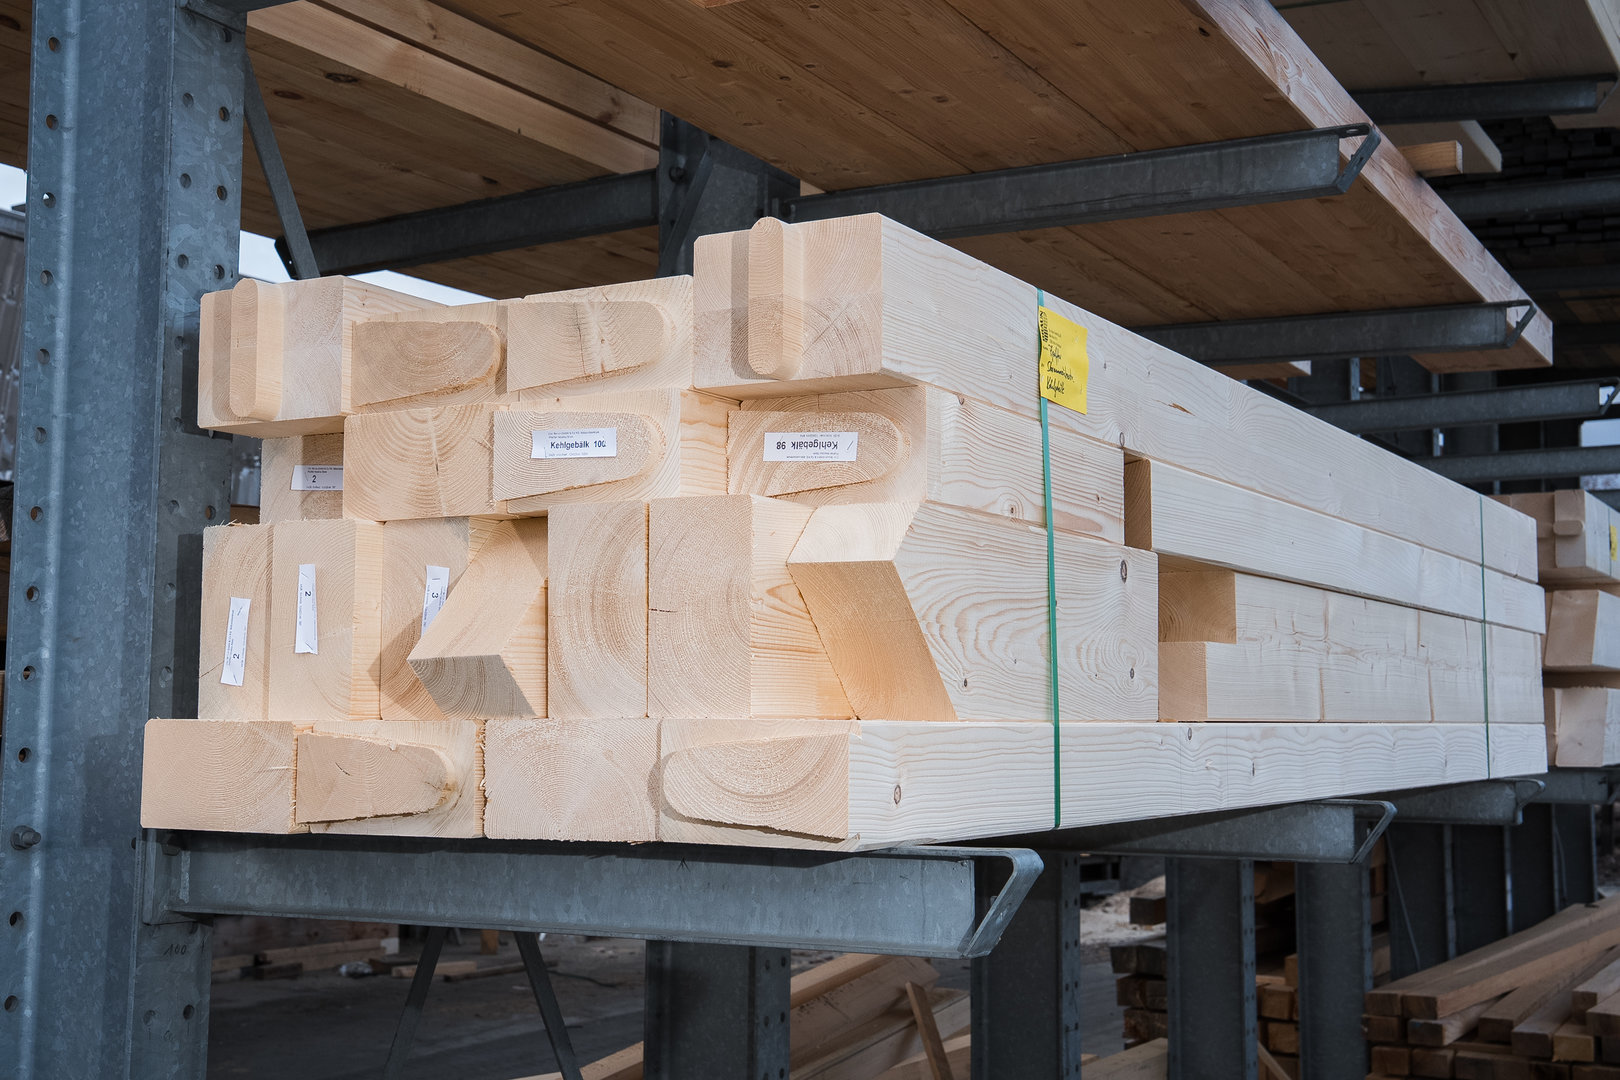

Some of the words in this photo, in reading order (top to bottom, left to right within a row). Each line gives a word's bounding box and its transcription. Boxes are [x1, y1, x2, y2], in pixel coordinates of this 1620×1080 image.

[550, 440, 590, 451] Kehlgebälk
[594, 440, 607, 448] 100
[776, 441, 786, 450] 98
[791, 439, 838, 450] Kehlgebälk
[312, 474, 317, 483] 2
